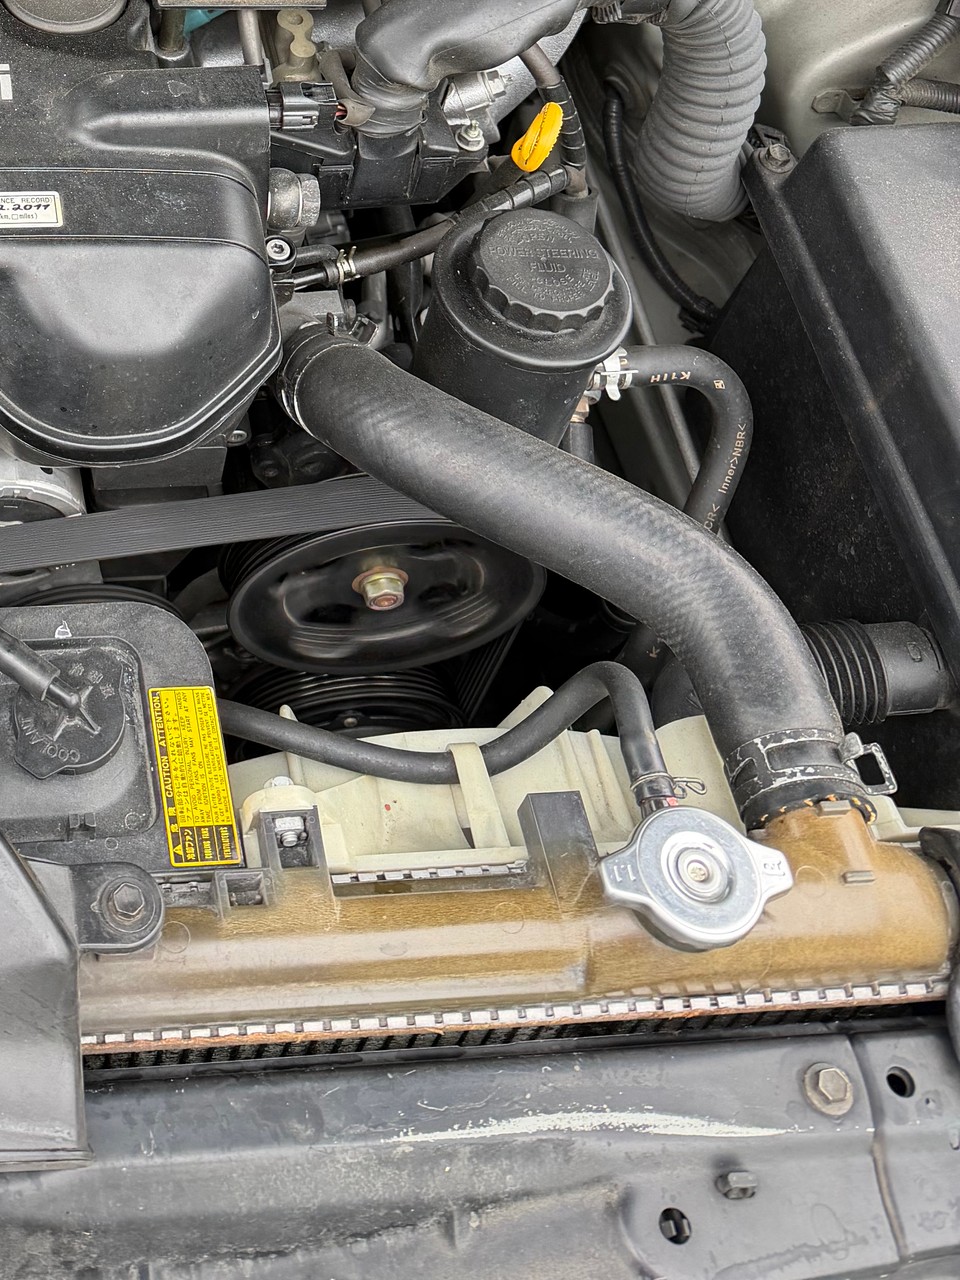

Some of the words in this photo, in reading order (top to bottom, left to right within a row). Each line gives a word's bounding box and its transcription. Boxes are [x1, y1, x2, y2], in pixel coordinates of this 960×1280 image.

[489, 246, 533, 257] POWER
[536, 247, 600, 260] STEERING
[529, 262, 567, 273] FLUID
[21, 716, 81, 763] COOLANT
[153, 696, 166, 747] ATTENTION
[161, 755, 173, 798] CAUTION
